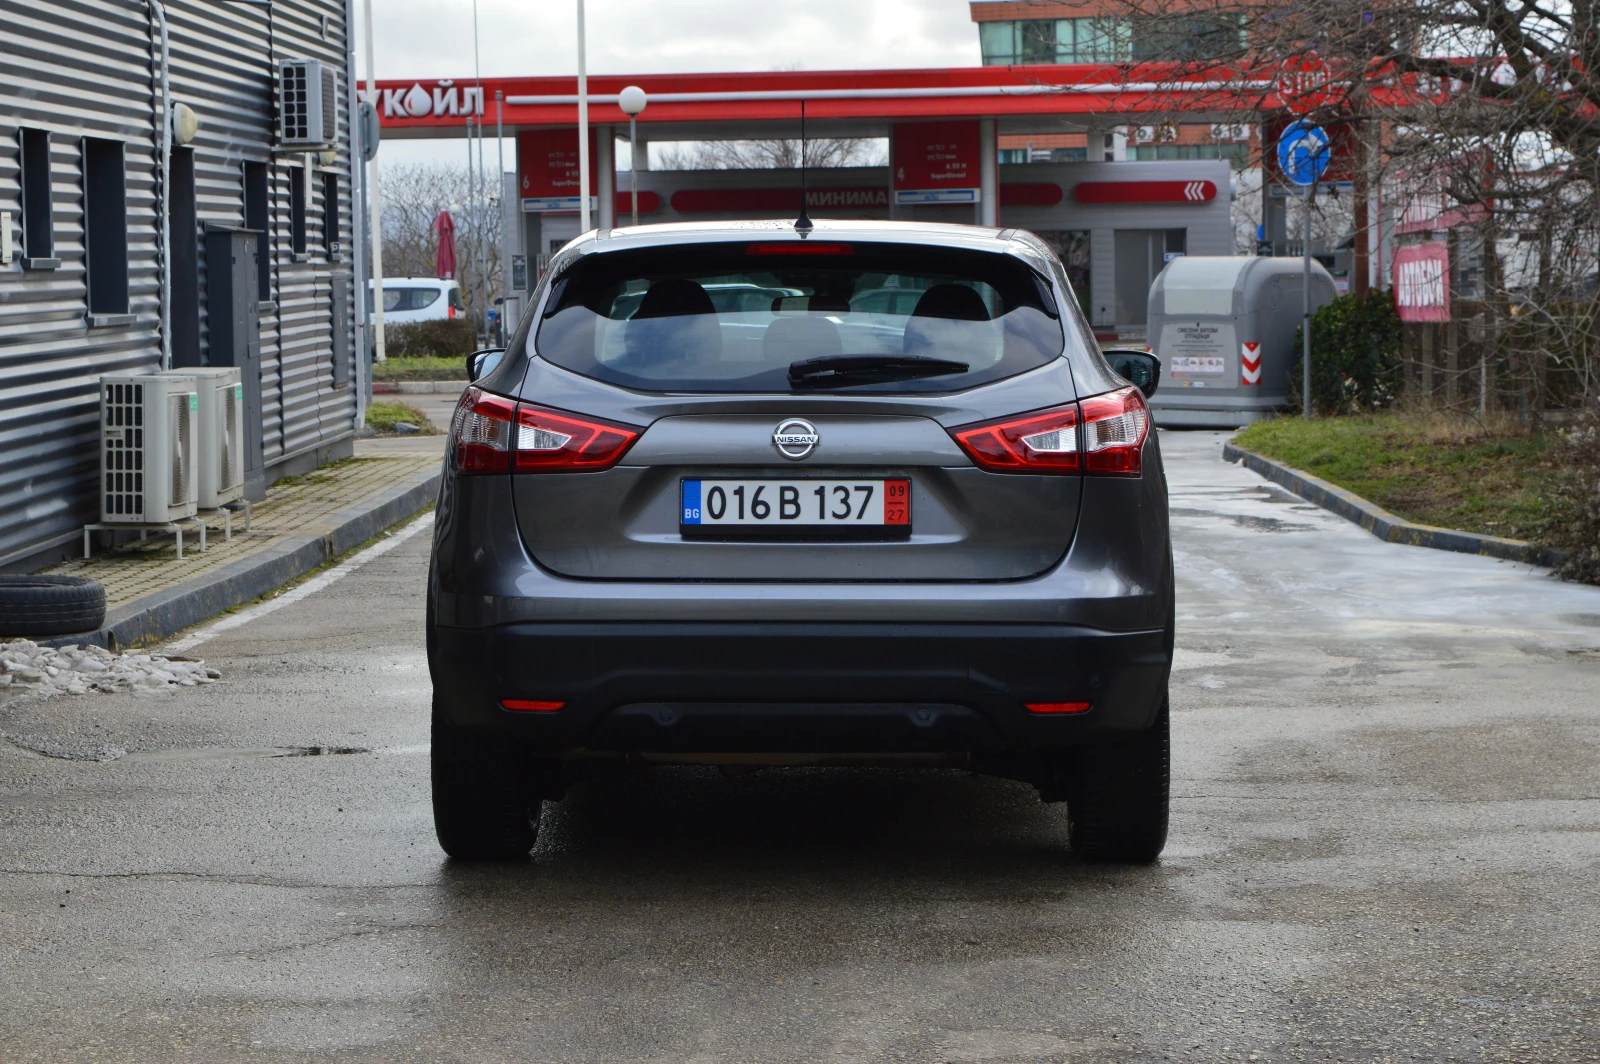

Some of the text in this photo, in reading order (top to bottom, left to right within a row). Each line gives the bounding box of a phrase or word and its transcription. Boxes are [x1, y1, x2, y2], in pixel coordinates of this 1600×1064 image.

[897, 167, 905, 182] 4
[523, 175, 530, 190] 6
[775, 435, 815, 444] NISSAN
[889, 485, 905, 497] 09
[706, 484, 874, 520] 016 B 137
[684, 508, 700, 519] BG
[887, 509, 904, 521] 27
